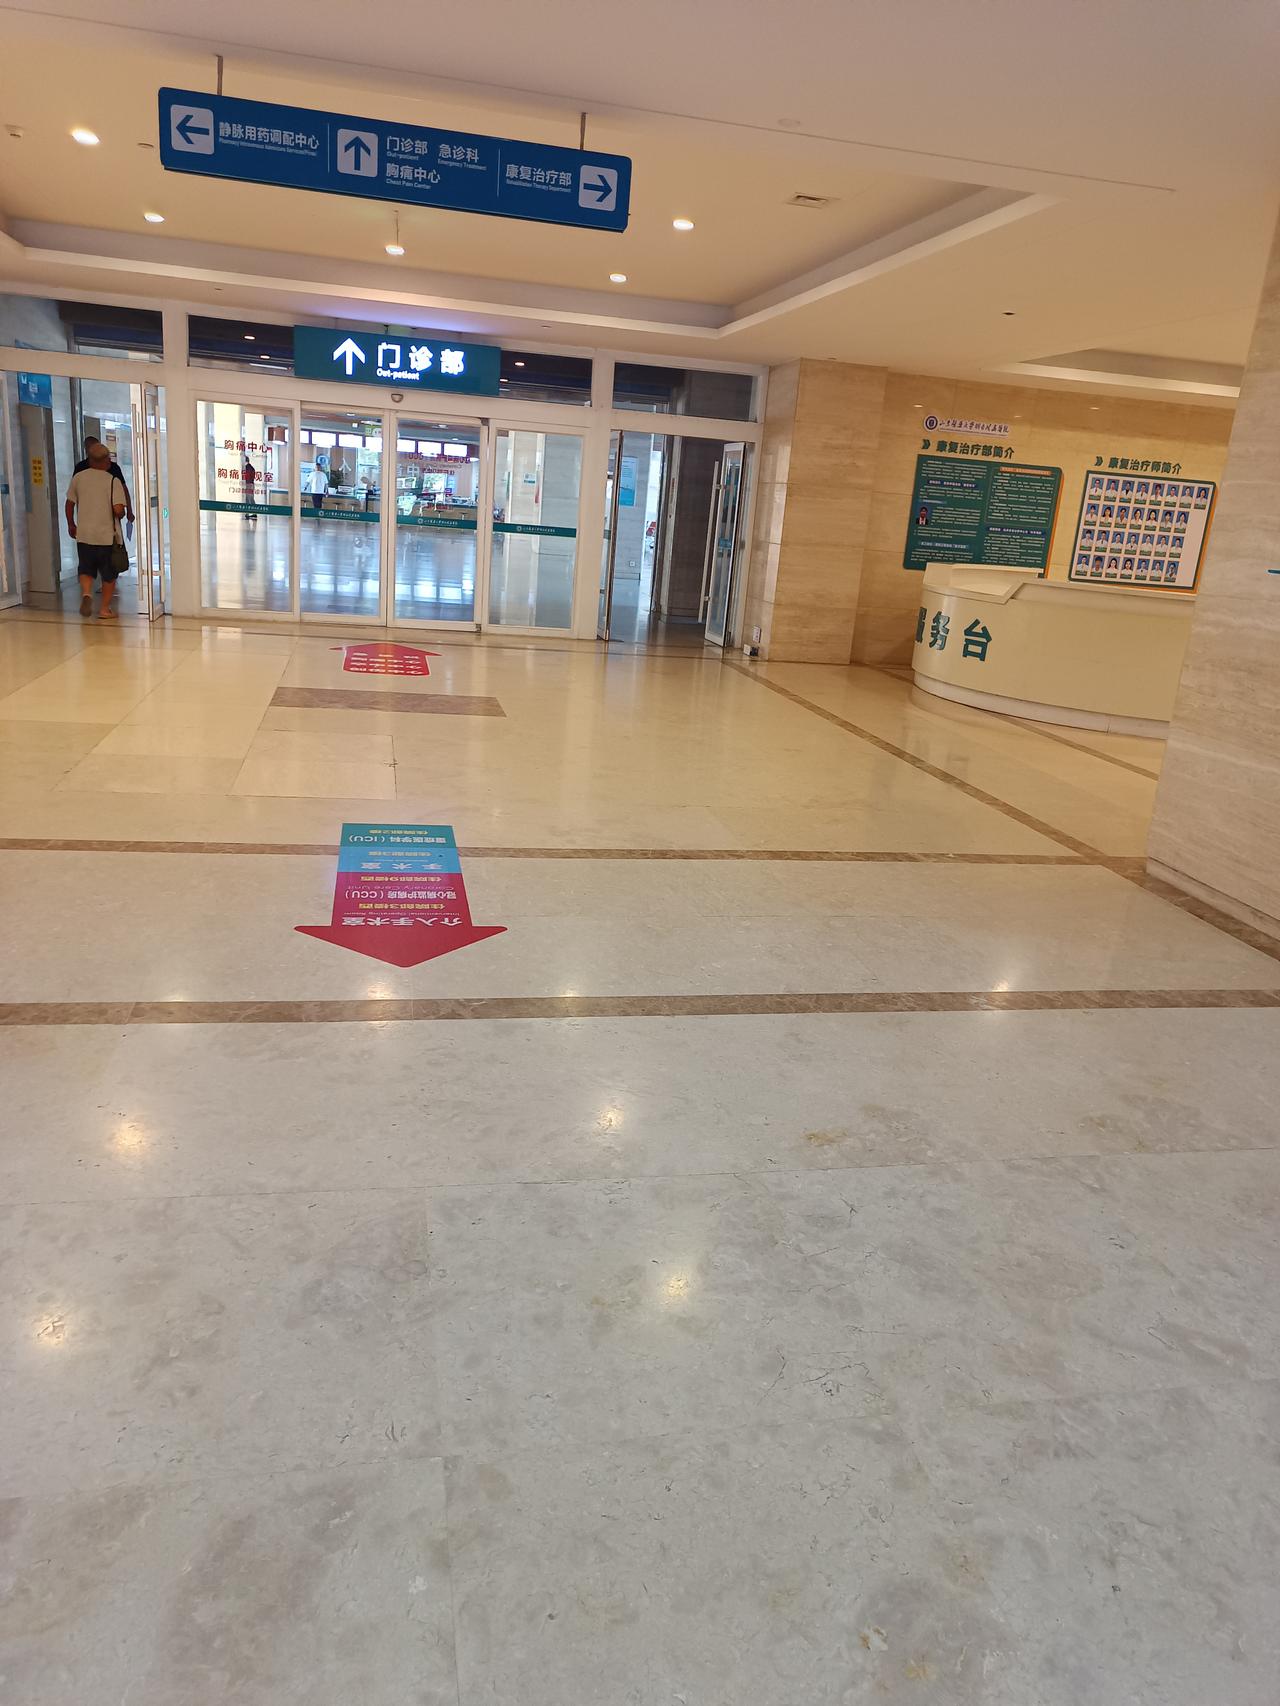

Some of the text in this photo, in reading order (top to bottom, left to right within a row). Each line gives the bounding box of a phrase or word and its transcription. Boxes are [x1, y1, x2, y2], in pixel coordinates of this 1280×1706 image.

[219, 122, 320, 150] 静脉用药调配中心
[386, 136, 428, 155] 门诊部
[438, 143, 480, 163] 急诊科
[386, 163, 441, 184] 胸痛中心
[505, 163, 572, 187] 康复治疗部
[377, 341, 466, 375] 门诊部
[376, 367, 421, 381] Out-patient
[224, 439, 269, 454] 胸痛中心
[936, 440, 1015, 460] 康复治疗部简介
[1107, 456, 1183, 475] 康复治疗师简介
[341, 916, 463, 926] 介入手术室
